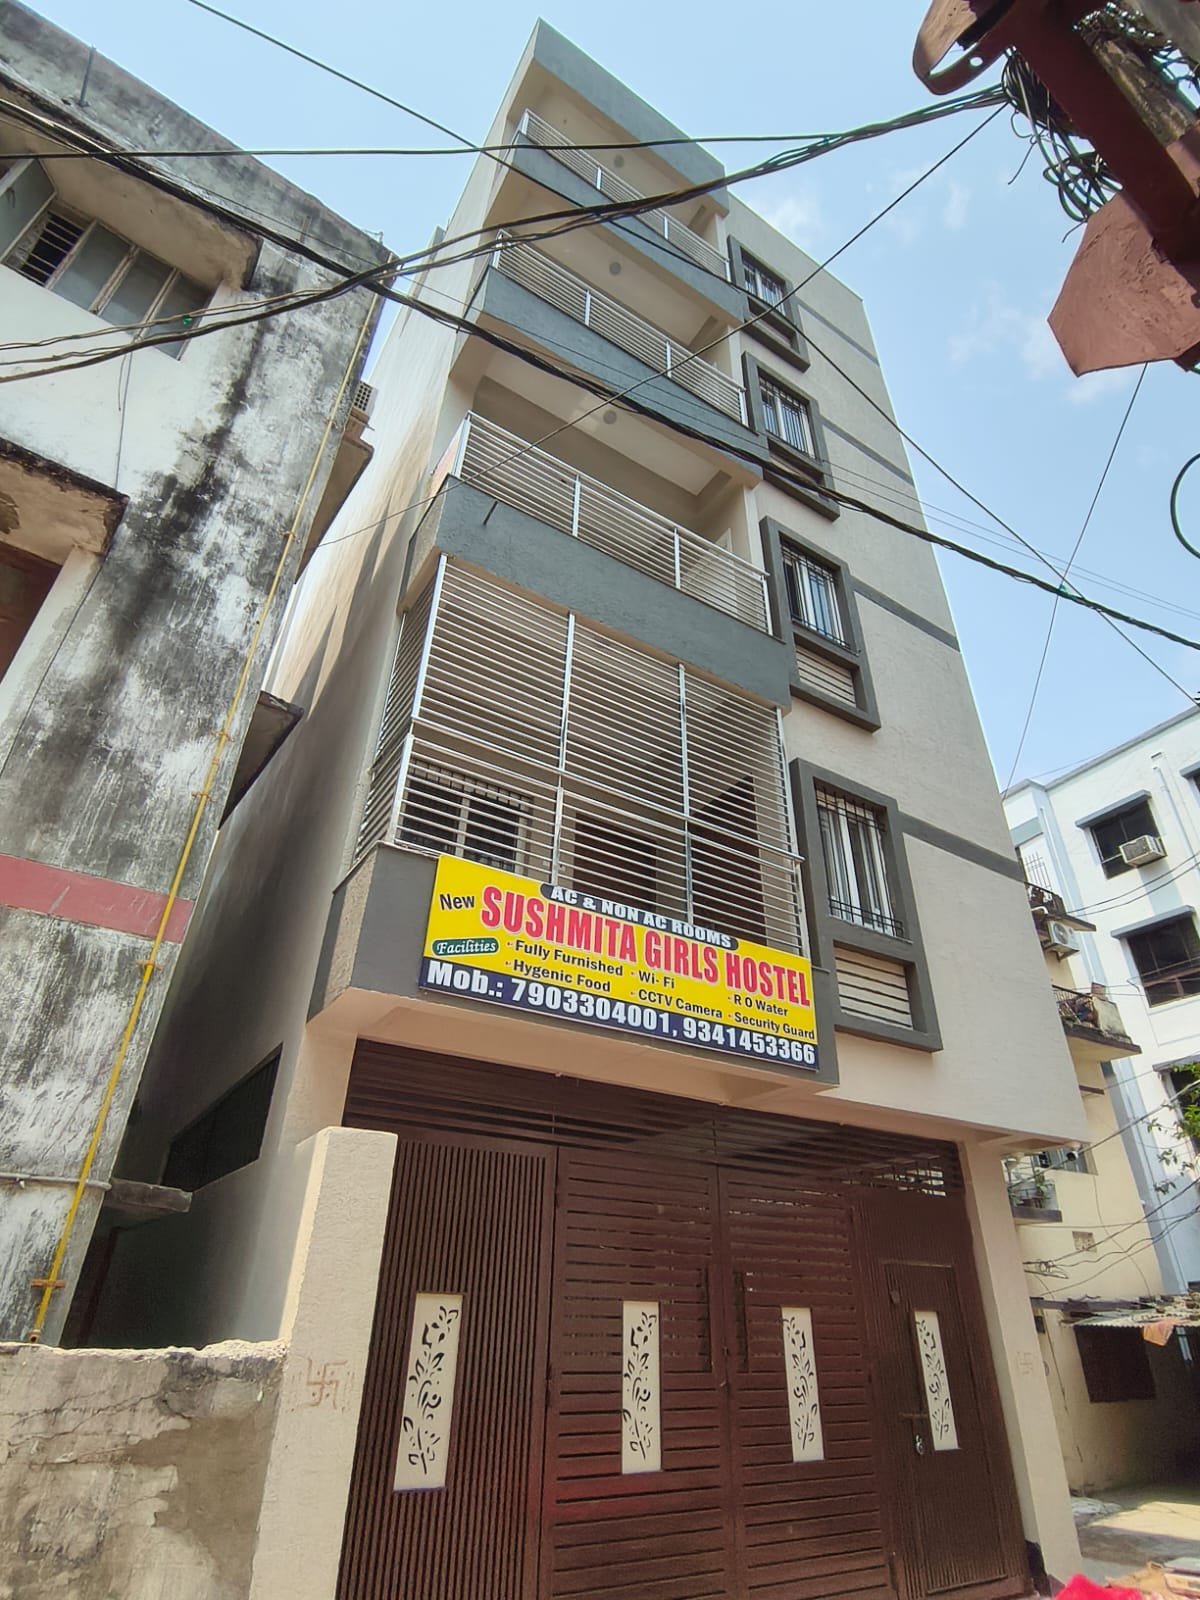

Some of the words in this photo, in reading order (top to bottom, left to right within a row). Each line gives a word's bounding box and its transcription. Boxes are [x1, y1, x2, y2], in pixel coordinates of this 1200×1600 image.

[551, 886, 577, 904] AC
[583, 896, 596, 910] &
[602, 899, 639, 922] NON
[643, 911, 667, 929] AC
[672, 920, 732, 948] ROOMS
[436, 940, 496, 955] Facilities
[439, 893, 475, 910] New
[481, 886, 637, 963] SUSHMITA
[645, 930, 718, 984] GIRLS
[726, 952, 811, 1007] HOSTEL
[515, 939, 550, 961] Fully
[554, 949, 623, 976] Furnished
[513, 959, 573, 984] Hygenic
[577, 974, 611, 993] Food
[427, 960, 504, 998] Mob.:
[683, 1017, 815, 1065] 9341453366
[638, 988, 673, 1007] CCTV
[676, 998, 722, 1019] Camera
[734, 995, 741, 1006] R
[745, 997, 753, 1008] O
[755, 999, 788, 1017] Water
[734, 1011, 780, 1033] Security
[783, 1023, 815, 1040] Guard
